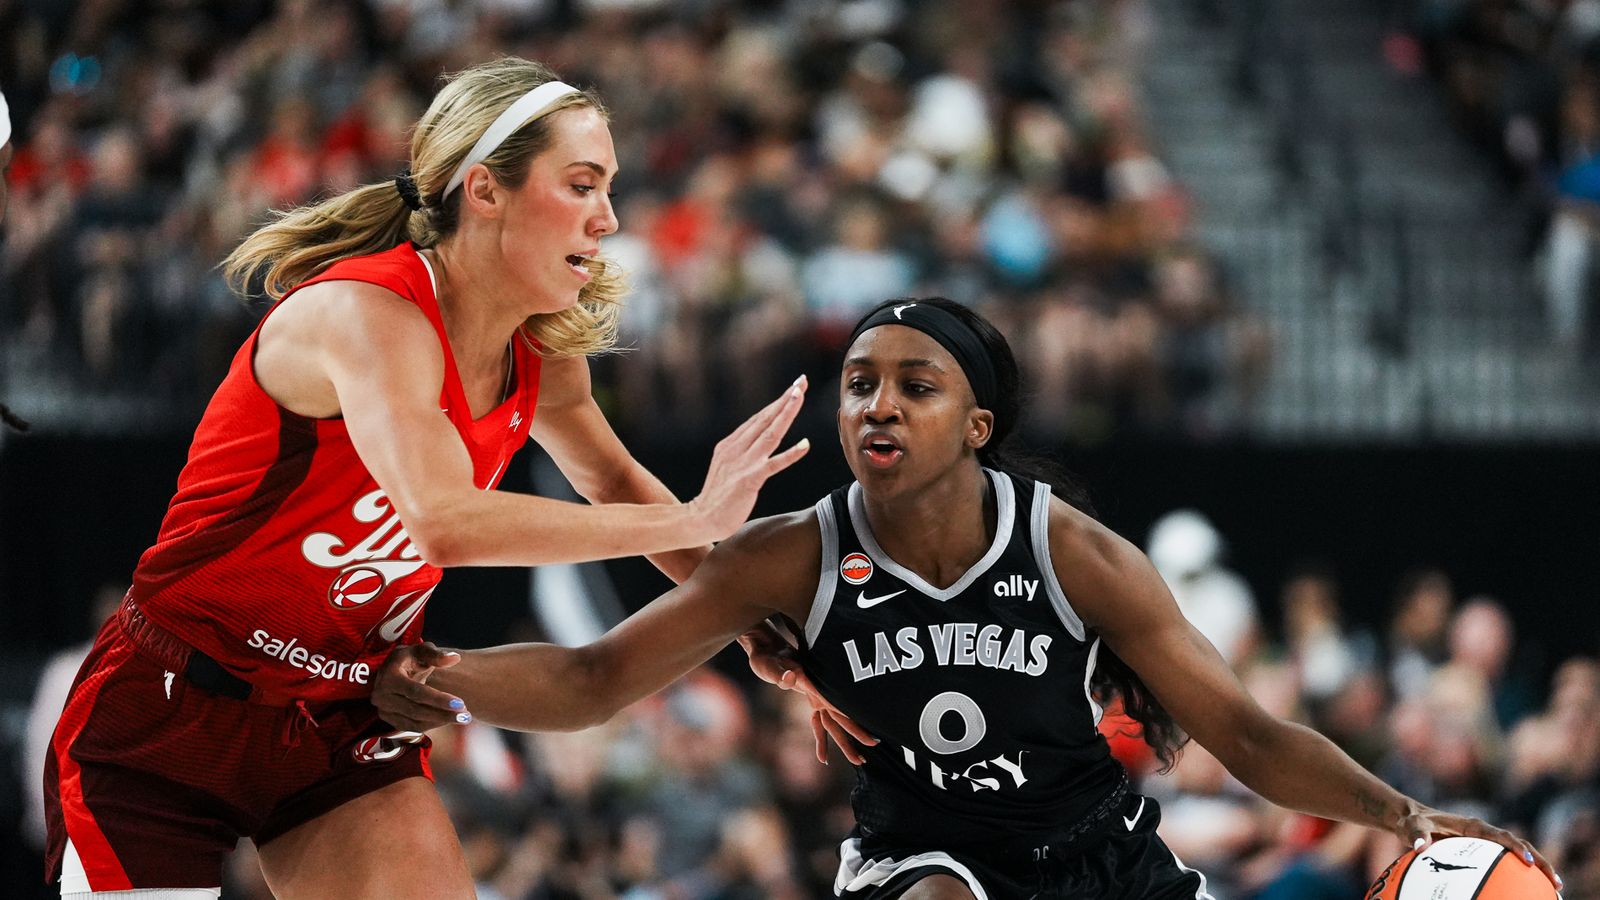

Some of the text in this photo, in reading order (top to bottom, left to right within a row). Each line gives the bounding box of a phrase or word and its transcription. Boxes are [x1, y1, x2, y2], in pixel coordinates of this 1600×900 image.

[508, 410, 523, 433] lly
[993, 574, 1039, 602] ally
[246, 629, 370, 685] salesorce
[842, 622, 1053, 683] LAS VEGAS
[918, 691, 987, 755] 0
